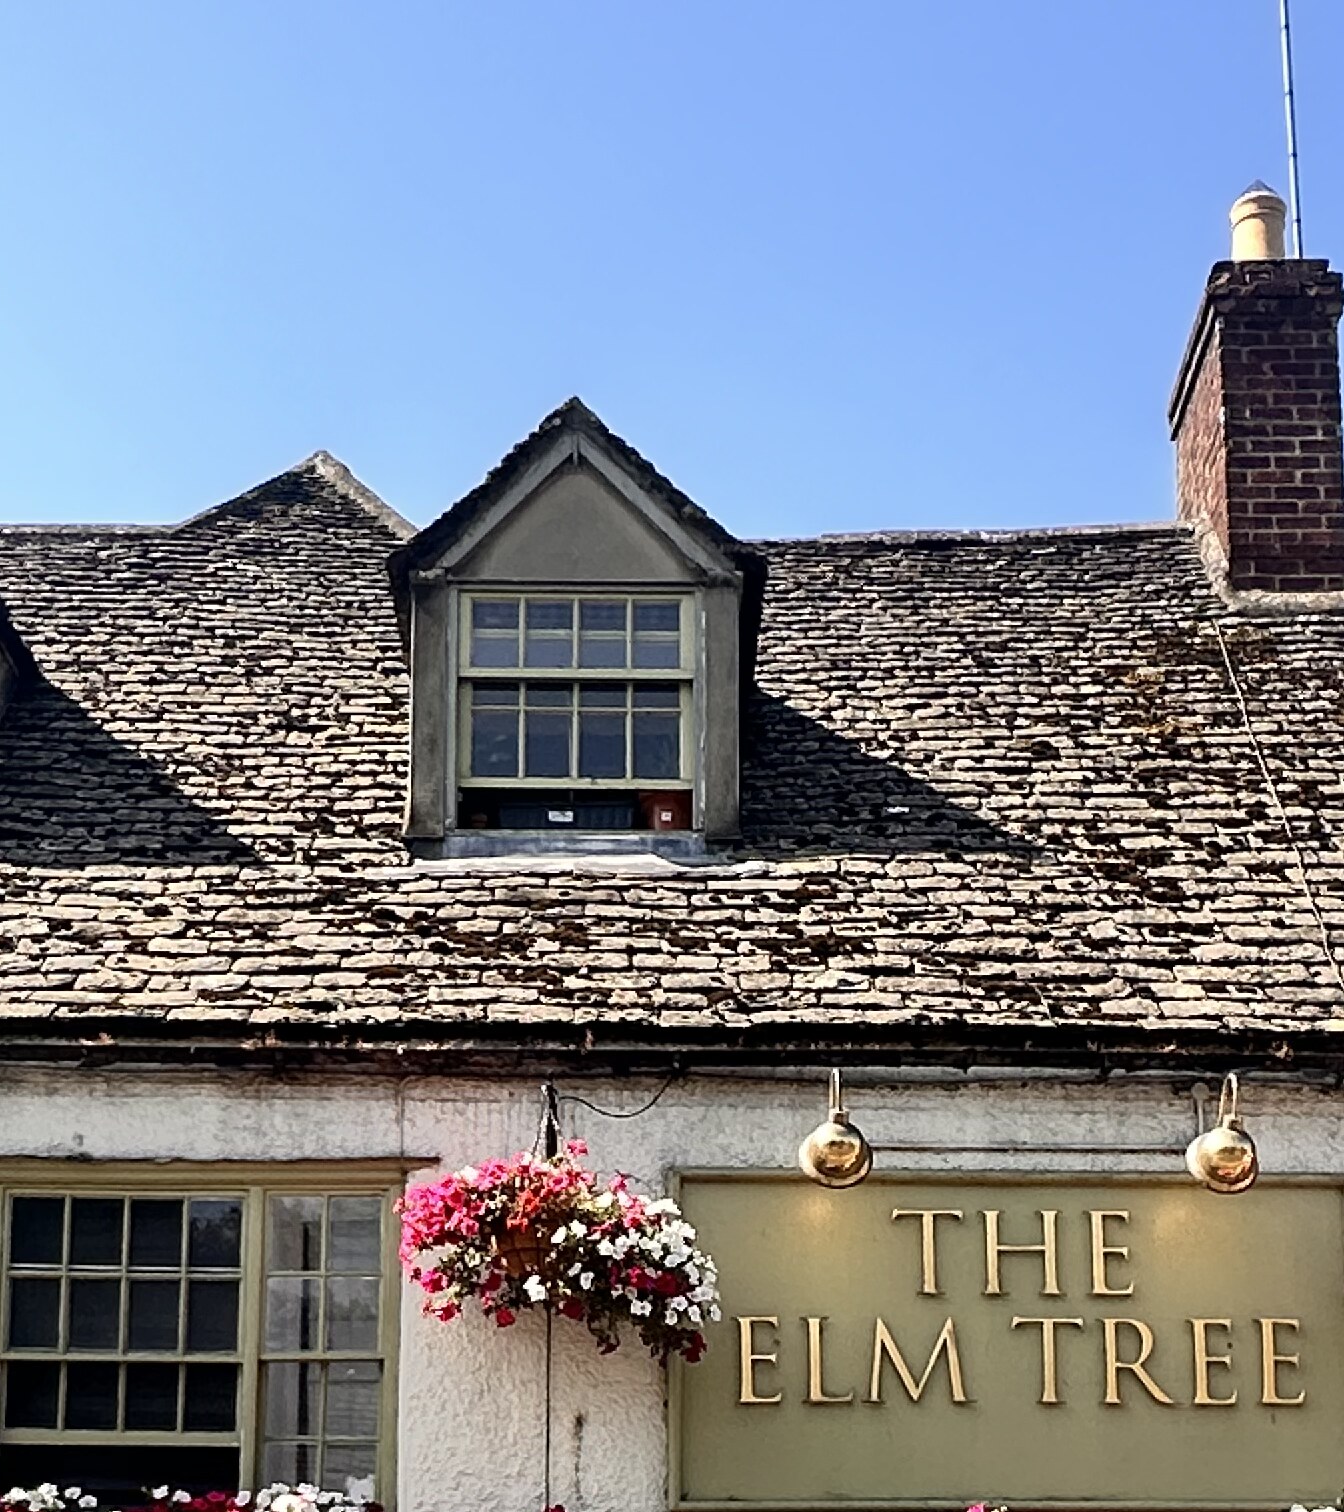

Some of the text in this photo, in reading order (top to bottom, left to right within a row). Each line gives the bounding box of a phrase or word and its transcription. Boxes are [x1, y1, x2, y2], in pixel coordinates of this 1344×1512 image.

[891, 1208, 1136, 1298] THE
[735, 1314, 1307, 1407] ELM TREE
